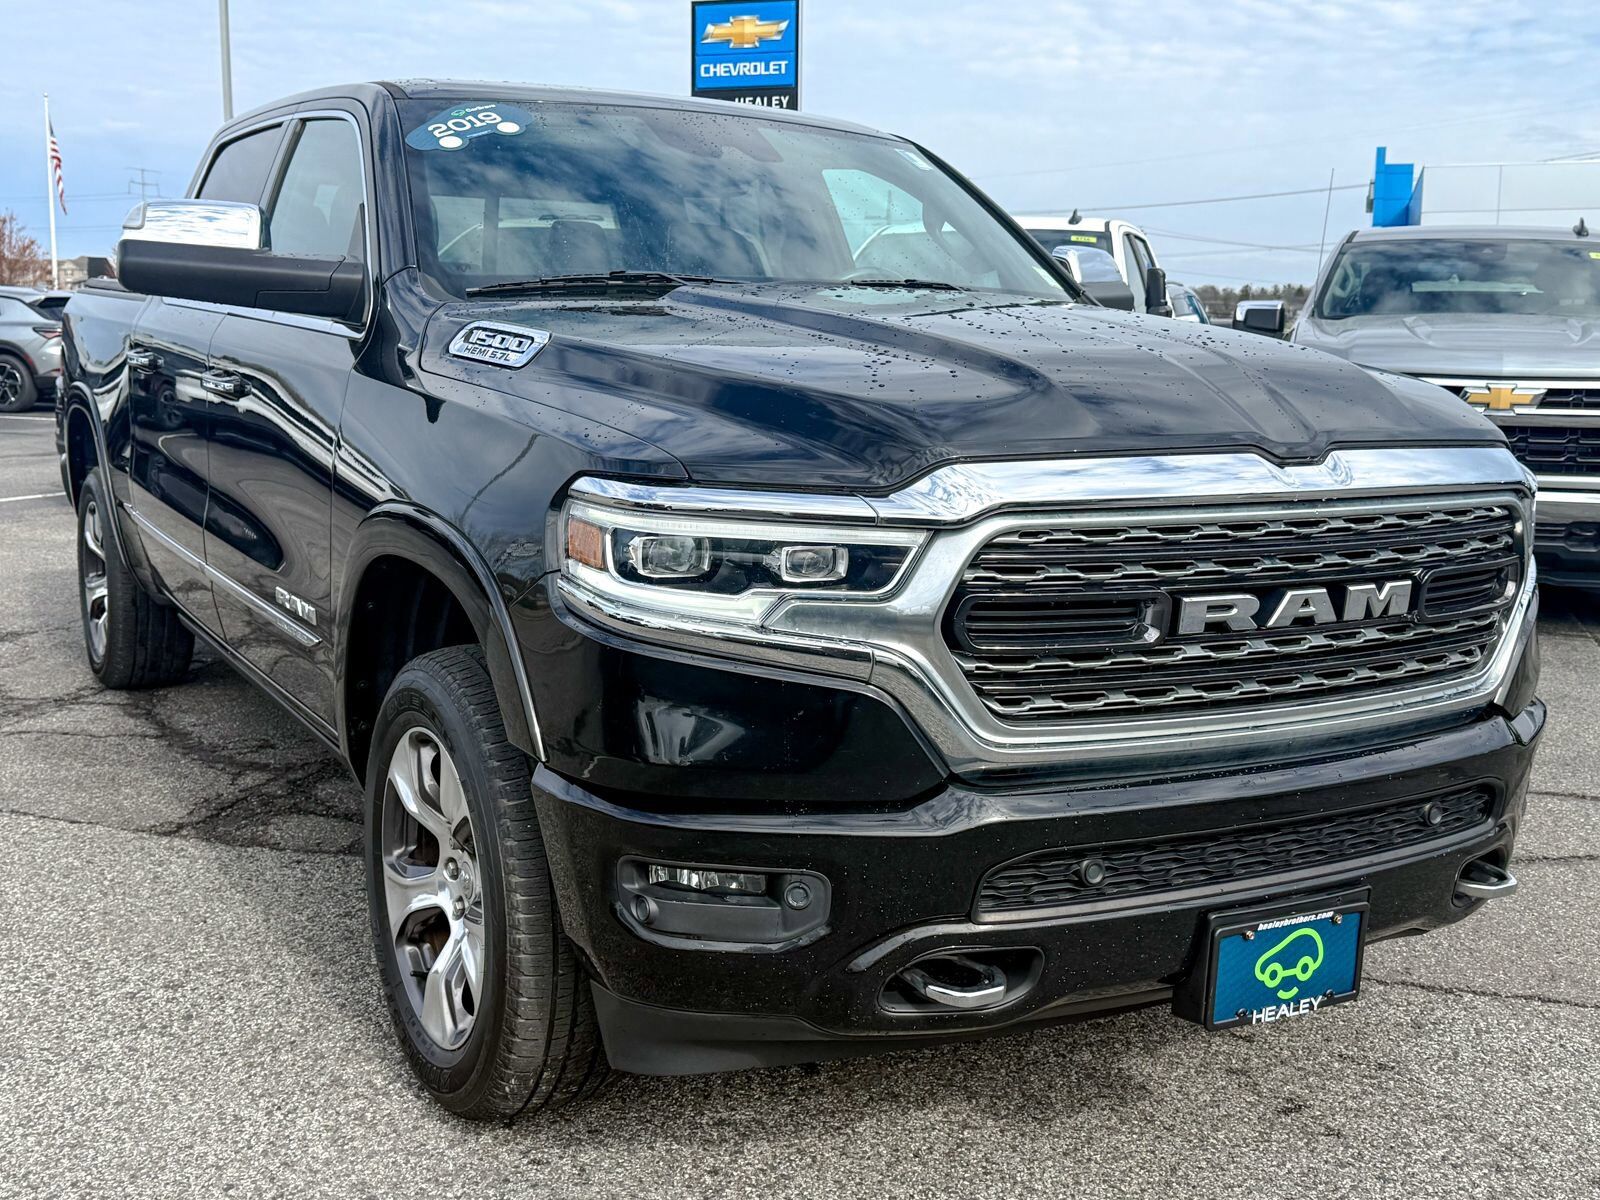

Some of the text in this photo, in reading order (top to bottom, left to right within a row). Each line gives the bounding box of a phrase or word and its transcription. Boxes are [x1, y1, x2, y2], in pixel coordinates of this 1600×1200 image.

[700, 60, 789, 78] CHEVROLET
[427, 111, 502, 138] 2019
[463, 344, 511, 362] HEMI 5.7L
[469, 329, 531, 352] 1500
[275, 585, 318, 626] RAM
[1178, 579, 1413, 635] RAM
[1257, 911, 1334, 931] healeybrothers.com
[1252, 995, 1323, 1025] HEALEY
